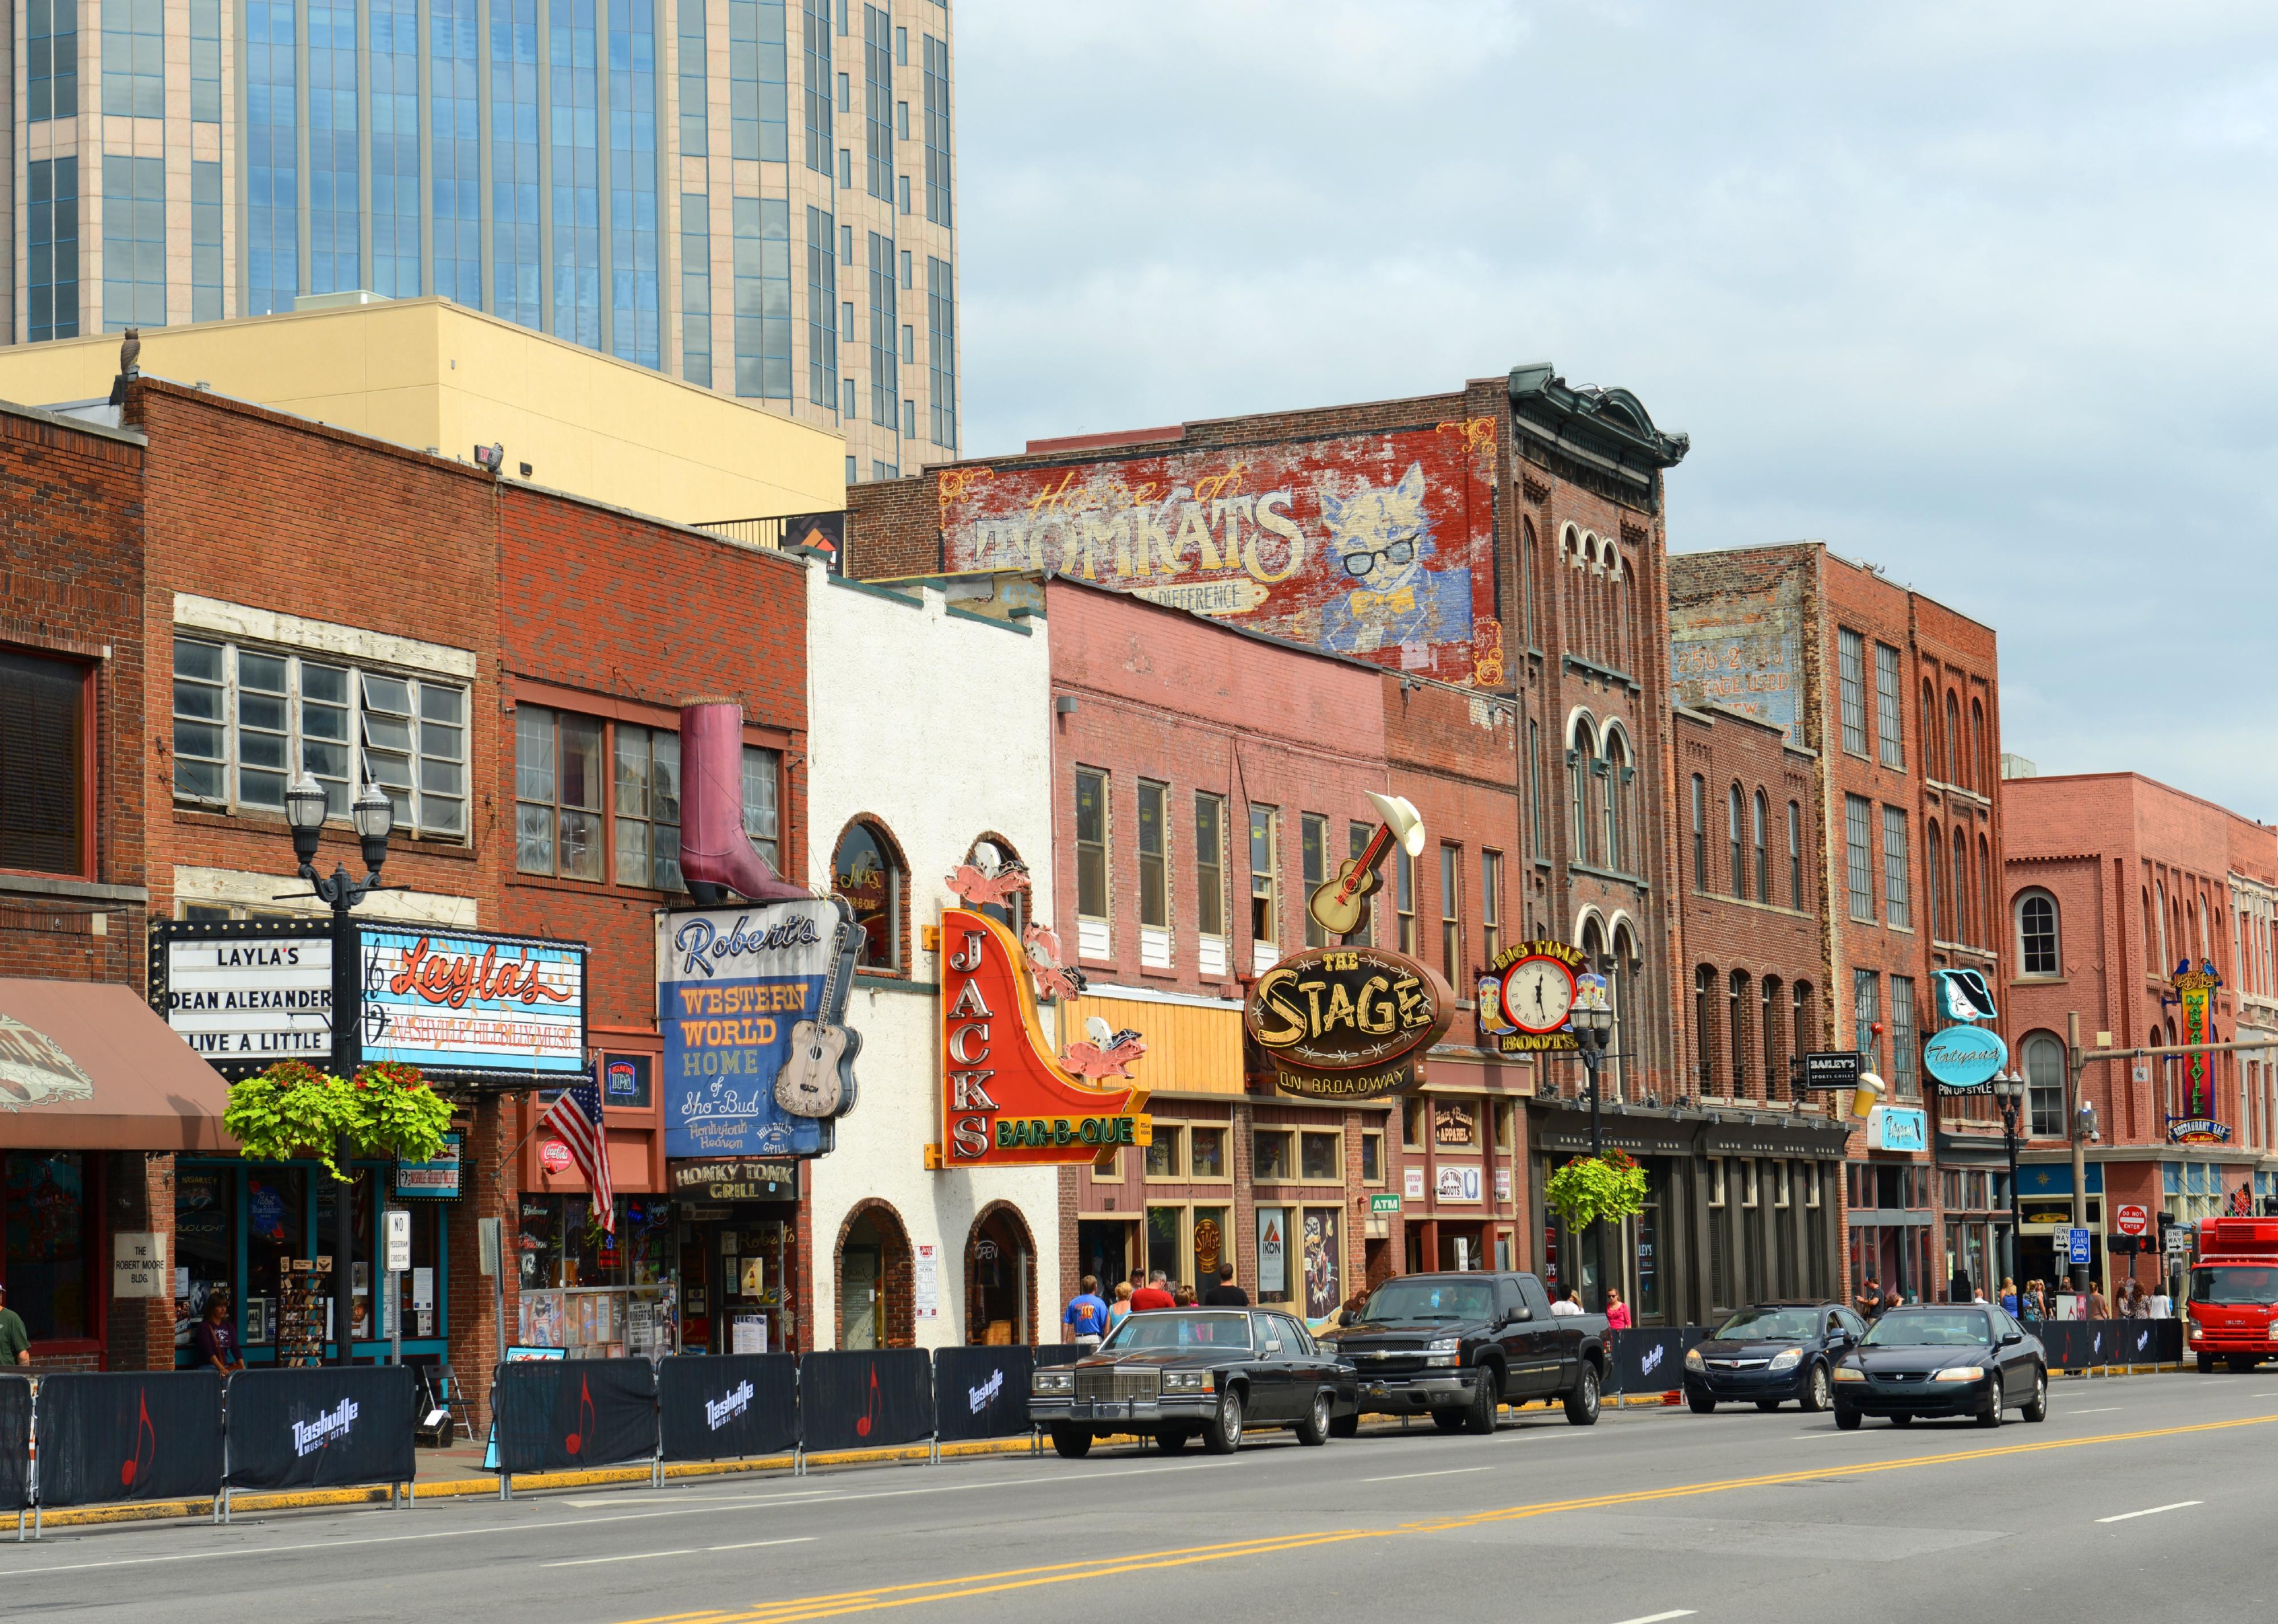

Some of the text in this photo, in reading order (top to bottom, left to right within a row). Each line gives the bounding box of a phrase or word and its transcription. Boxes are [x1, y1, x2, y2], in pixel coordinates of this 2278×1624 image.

[1194, 462, 1250, 507] of
[974, 487, 1305, 583] TOMKATS
[1159, 583, 1240, 610] DIFFERENCE
[1746, 674, 1790, 692] USED
[1728, 702, 1758, 715] EW
[840, 863, 881, 889] JACK'S
[675, 916, 821, 978] Robert's
[1495, 940, 1584, 969] BIG TIME
[218, 948, 299, 966] LAYLA'S
[1323, 952, 1359, 971] THE
[390, 937, 573, 1009] Layla's
[2169, 971, 2202, 988] Jimmy
[170, 990, 332, 1009] DEAN ALEXANDER
[679, 984, 809, 1015] WESTERN
[1258, 969, 1432, 1047] STAGE
[189, 1033, 321, 1051] LIVE A LITTLE
[393, 1016, 576, 1050] NASHVILLE HILLBILLY MUSIC
[680, 1019, 777, 1047] WORLD
[946, 931, 999, 1158] JACKS
[1501, 1034, 1579, 1051] BOOTS
[684, 1050, 758, 1075] HOME
[1928, 1046, 2000, 1066] Tatyana
[2187, 995, 2204, 1114] MARGARTAVILLE
[610, 1066, 634, 1075] LAGUNITAS
[1811, 1059, 1855, 1069] BAILEY'S
[612, 1074, 632, 1090] IPA
[711, 1076, 724, 1097] of
[1280, 1067, 1407, 1093] ON BROADWAY
[1939, 1084, 1952, 1095] PIN
[1967, 1082, 1992, 1094] STYLE
[682, 1090, 758, 1115] Sho-Bud
[1435, 1106, 1472, 1126] Hats Boots
[689, 1120, 748, 1139] Honkytonk
[996, 1117, 1136, 1147] BAR-B-QUE
[1440, 1128, 1468, 1142] APPAREL
[2174, 1121, 2226, 1137] RESTAURANT BAR
[700, 1138, 743, 1149] Heaven
[762, 1142, 788, 1153] GRILL
[182, 1176, 211, 1185] NASHVILLE
[444, 1171, 456, 1184] MUSIC
[676, 1164, 794, 1186] HONKY TONK
[1450, 1171, 1462, 1188] TIME
[257, 1192, 275, 1205] Pabst
[710, 1183, 759, 1198] GRILL
[1443, 1185, 1460, 1195] BOOTS
[252, 1205, 281, 1214] Blue Ribbon
[1374, 1199, 1398, 1209] ATM
[395, 1217, 403, 1231] NO
[740, 1225, 795, 1249] Robet's
[1195, 1226, 1220, 1252] STAGE
[135, 1247, 146, 1255] THE
[975, 1246, 998, 1259] OPEN
[1263, 1242, 1280, 1254] IKON
[1639, 1244, 1652, 1256] LEY'S
[116, 1260, 164, 1270] ROBERT MOORE
[131, 1274, 149, 1283] BLDG.
[630, 1309, 651, 1322] ROBERT'S
[969, 1368, 1003, 1415] Nashville
[705, 1380, 753, 1431] Nashville
[975, 1400, 986, 1413] MUSI
[292, 1398, 358, 1456] Nashville
[715, 1413, 731, 1429] MUSIC
[304, 1427, 344, 1454] MUSIC CITY
